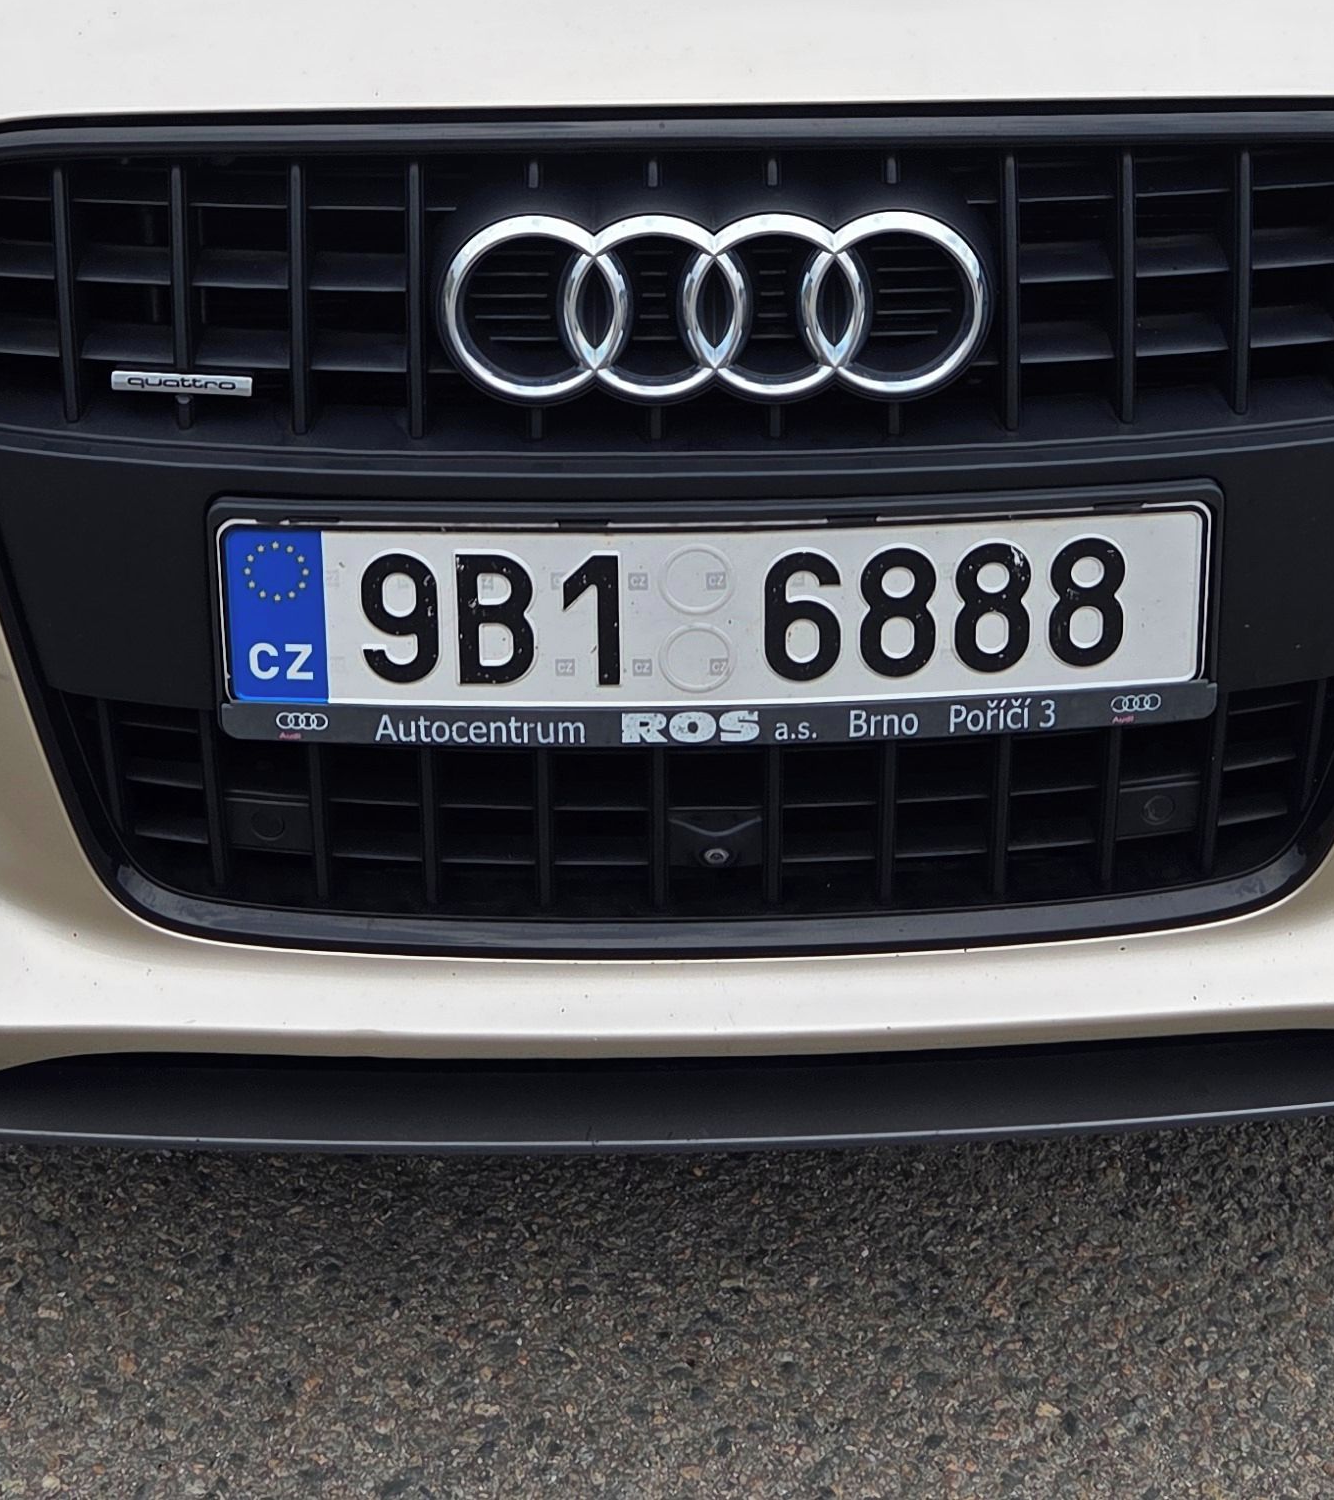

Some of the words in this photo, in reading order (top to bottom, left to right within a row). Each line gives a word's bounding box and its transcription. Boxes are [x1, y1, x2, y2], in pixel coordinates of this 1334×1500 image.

[127, 376, 236, 390] quattro
[360, 552, 621, 686] 9B1
[763, 537, 1126, 683] 6888
[248, 642, 314, 681] CZ
[374, 713, 586, 744] Autocentrum
[621, 710, 760, 743] ROS
[774, 720, 817, 740] a.s.
[848, 709, 919, 738] Brno
[949, 697, 1032, 733] Poříčí
[1039, 699, 1056, 729] 3
